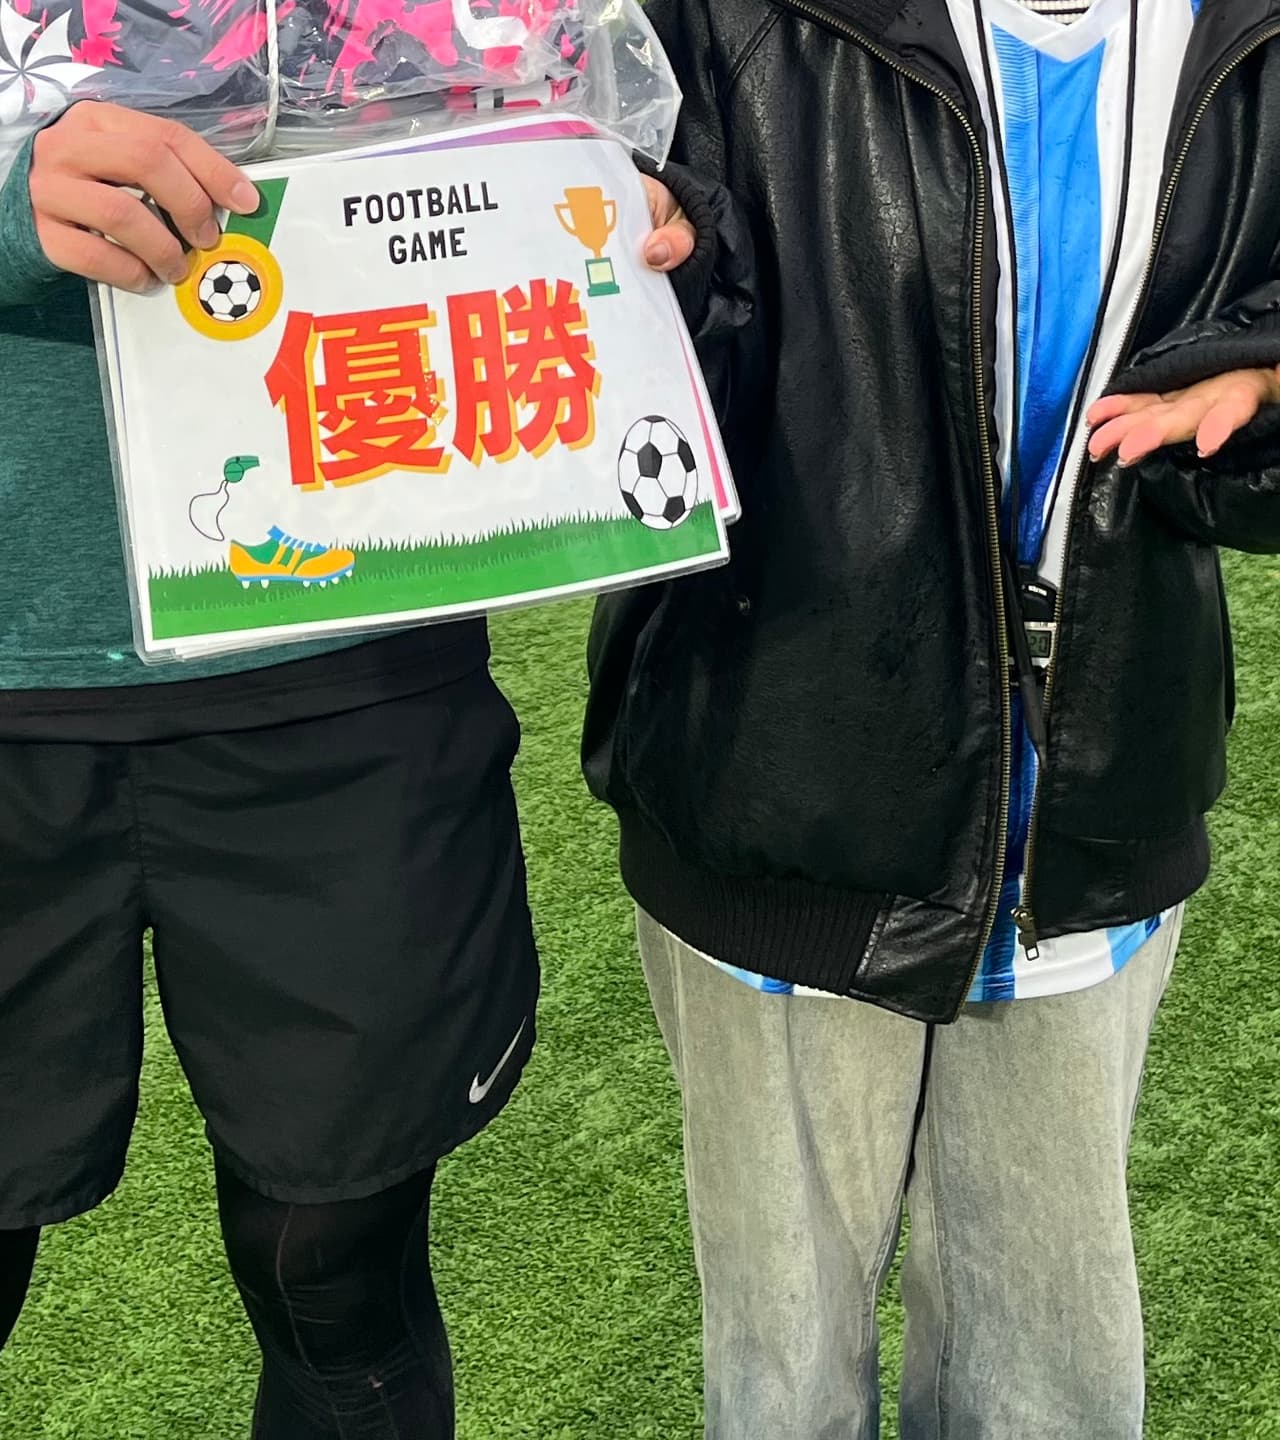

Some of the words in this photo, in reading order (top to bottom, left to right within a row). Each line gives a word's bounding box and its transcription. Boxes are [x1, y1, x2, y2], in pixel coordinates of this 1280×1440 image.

[342, 181, 499, 227] FOOTBALL
[388, 227, 468, 265] GAME
[264, 277, 600, 491] 優勝
